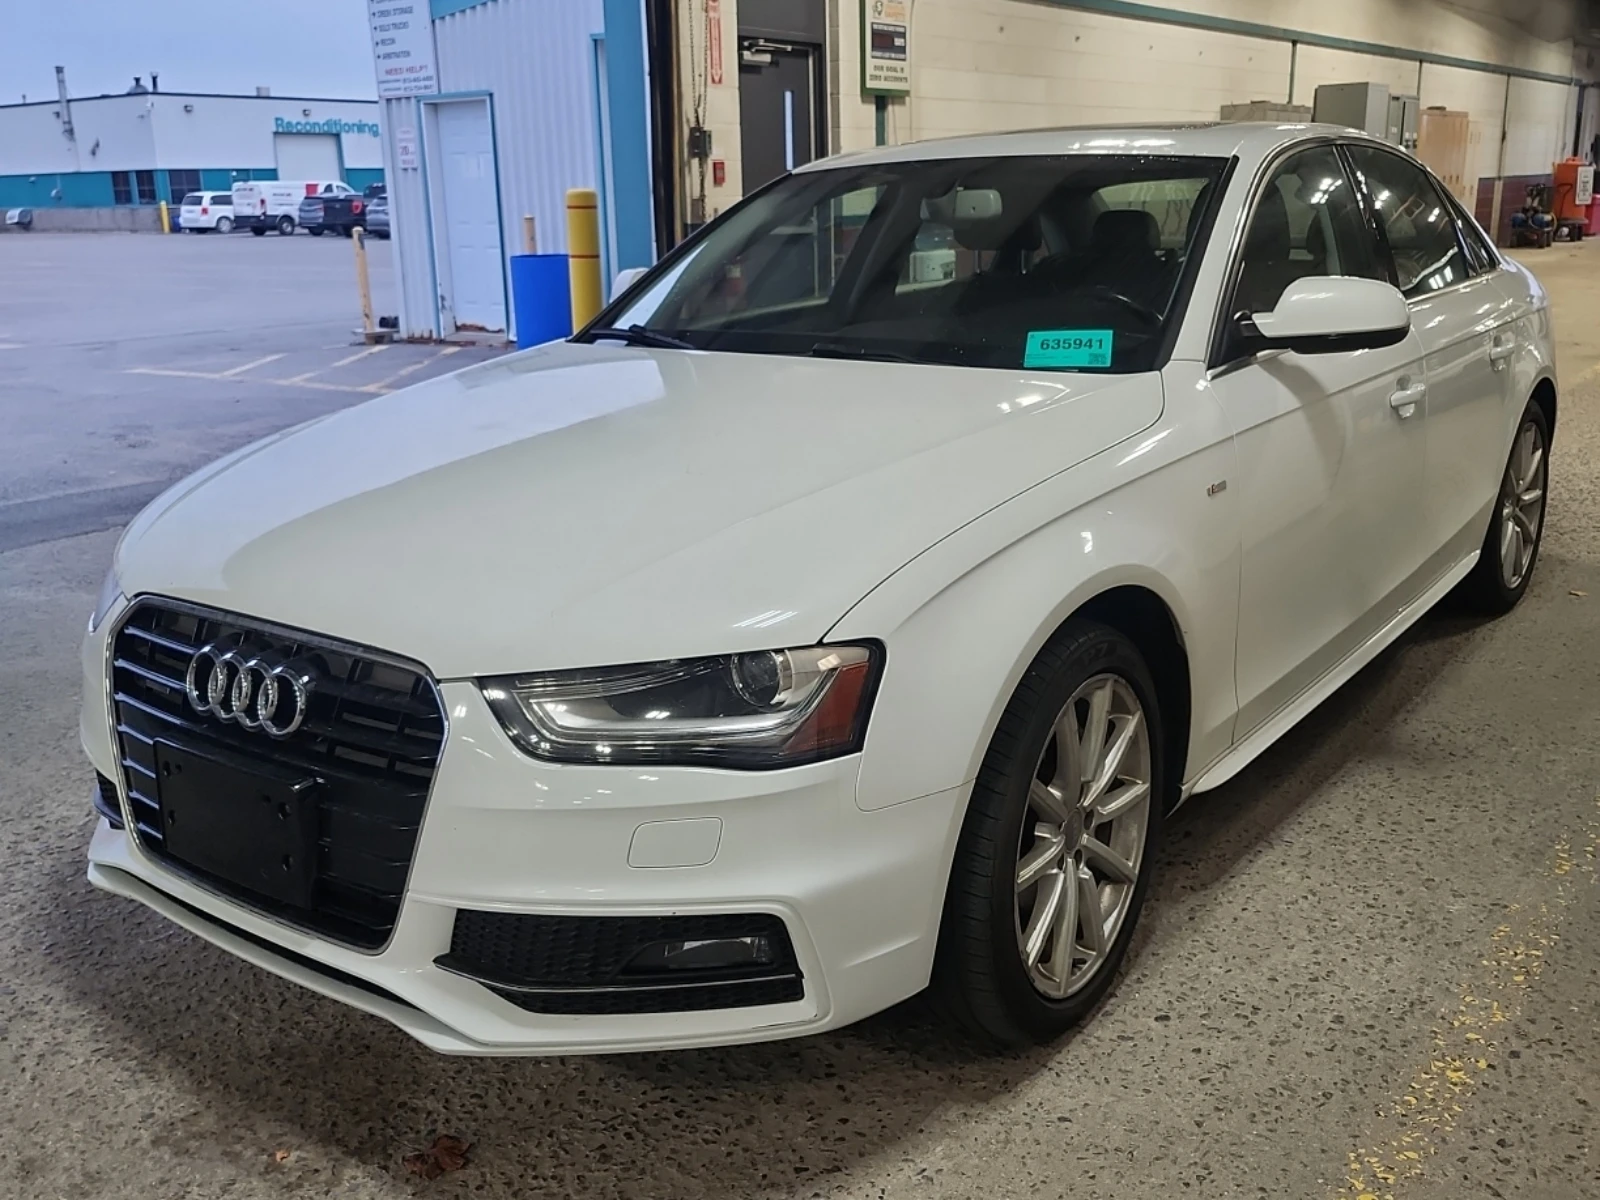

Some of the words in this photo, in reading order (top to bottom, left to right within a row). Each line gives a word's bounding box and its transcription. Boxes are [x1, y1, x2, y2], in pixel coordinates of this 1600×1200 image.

[385, 67, 404, 76] NEED
[275, 117, 379, 138] Reconditioning
[1040, 337, 1104, 351] 635941
